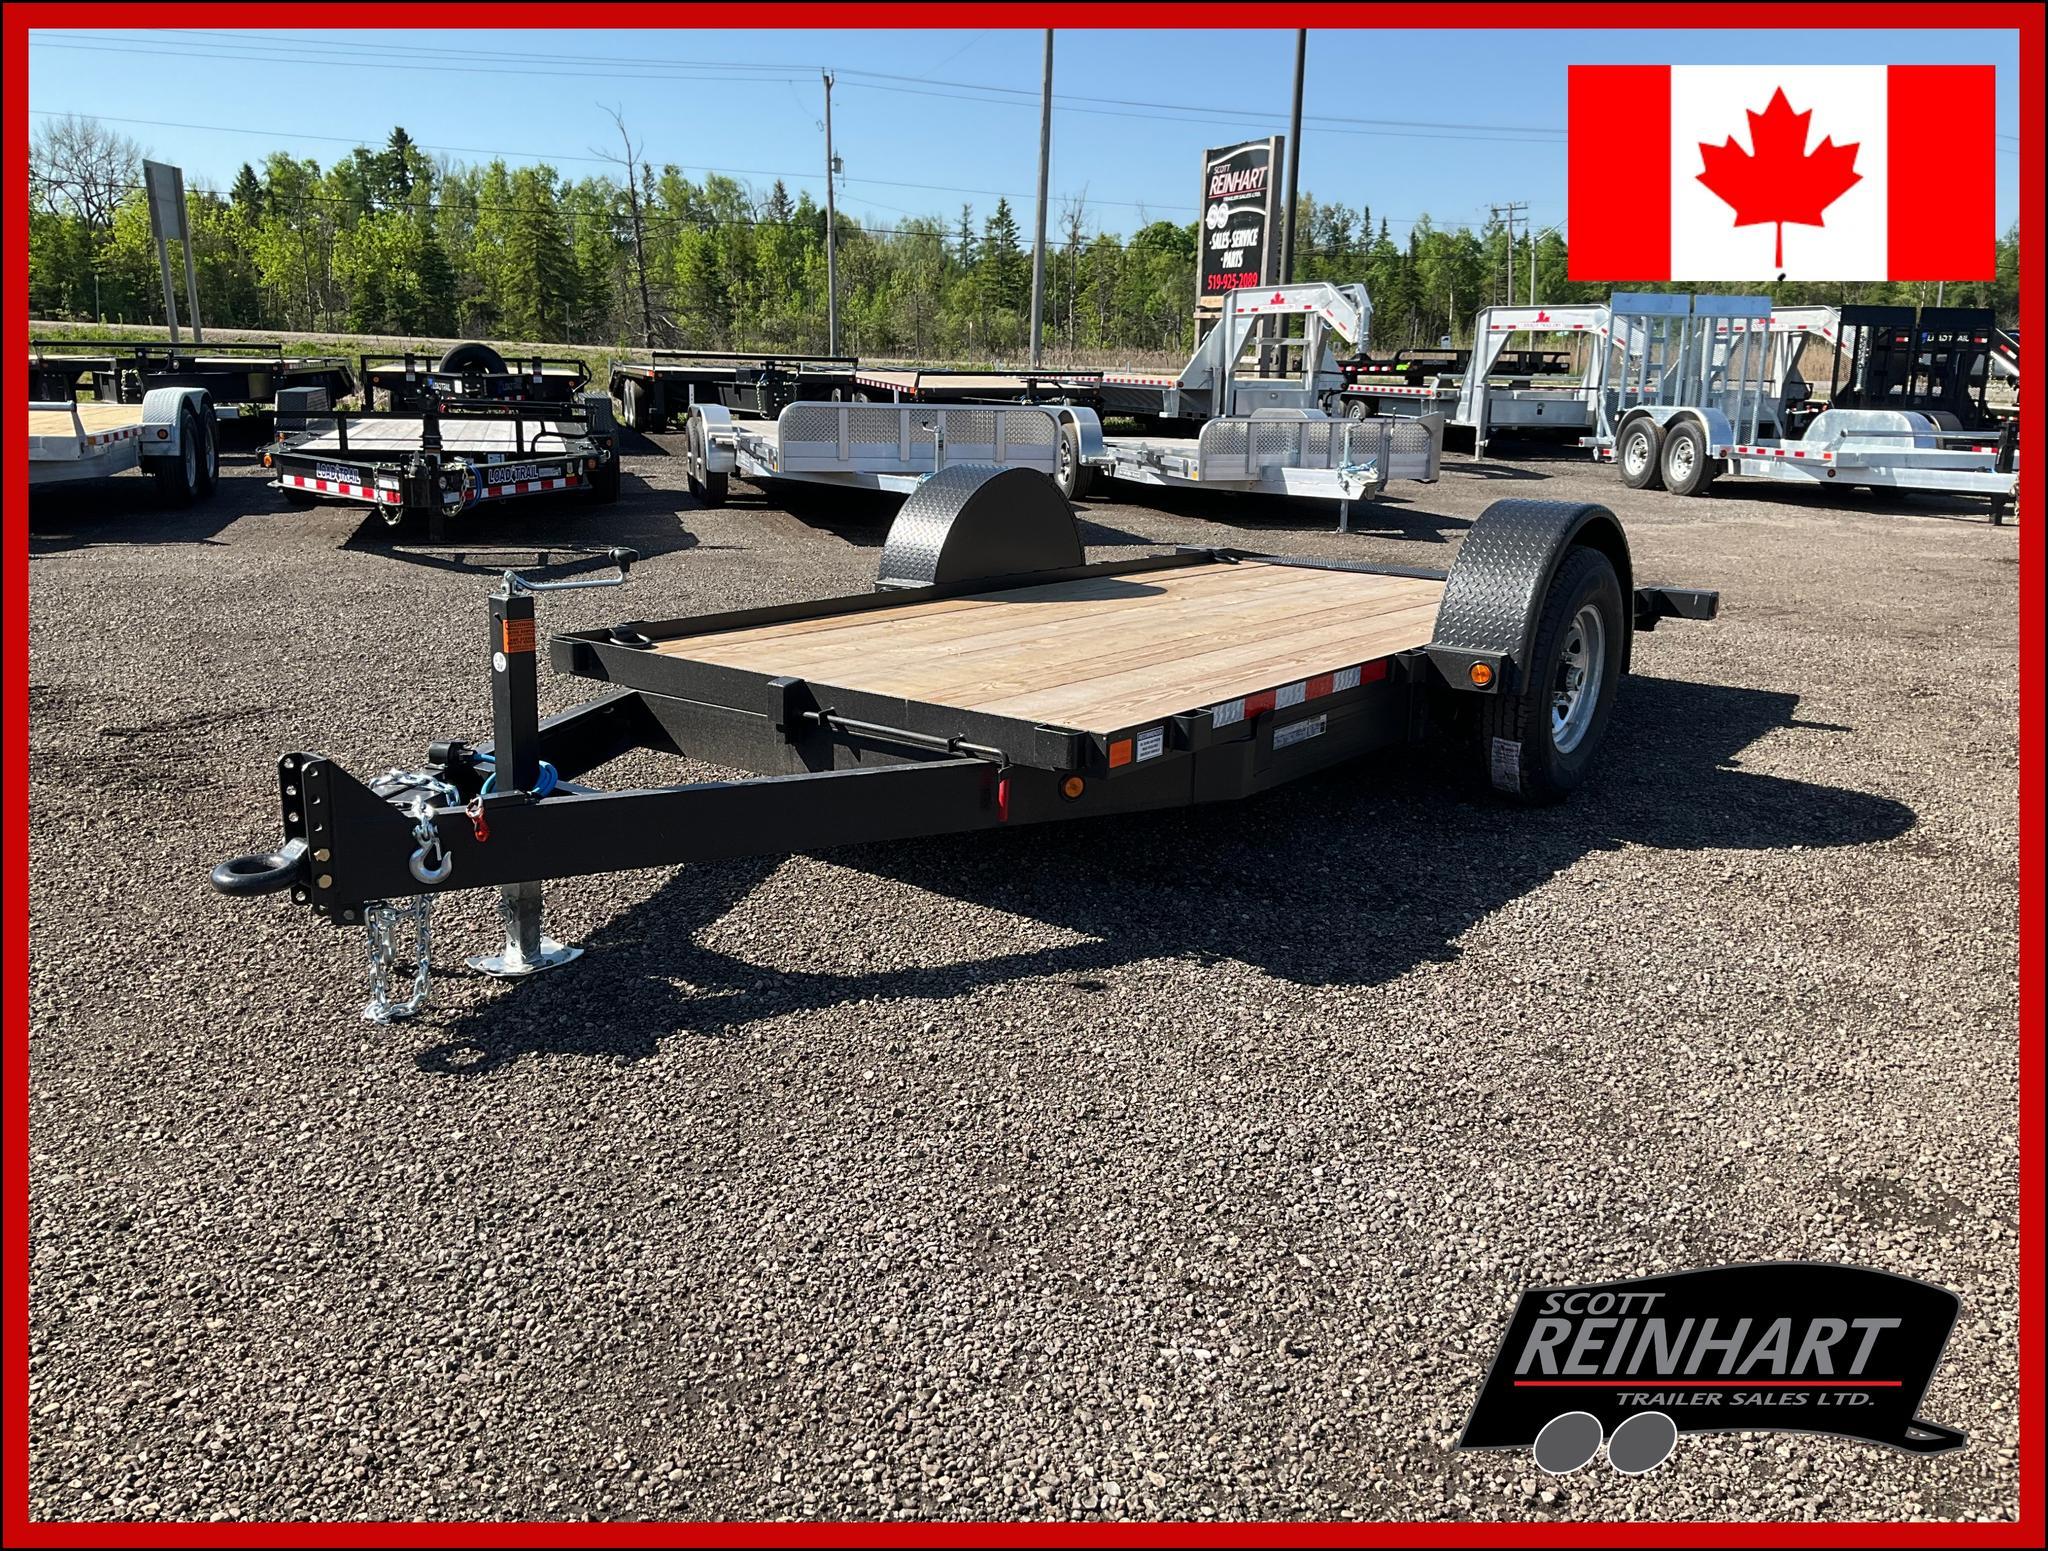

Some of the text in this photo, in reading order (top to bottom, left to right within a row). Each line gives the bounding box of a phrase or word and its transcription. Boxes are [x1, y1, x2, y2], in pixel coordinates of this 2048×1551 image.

[1213, 164, 1231, 174] SCOTT
[1209, 166, 1268, 195] REINHART
[1208, 272, 1258, 289] 519-925-2089
